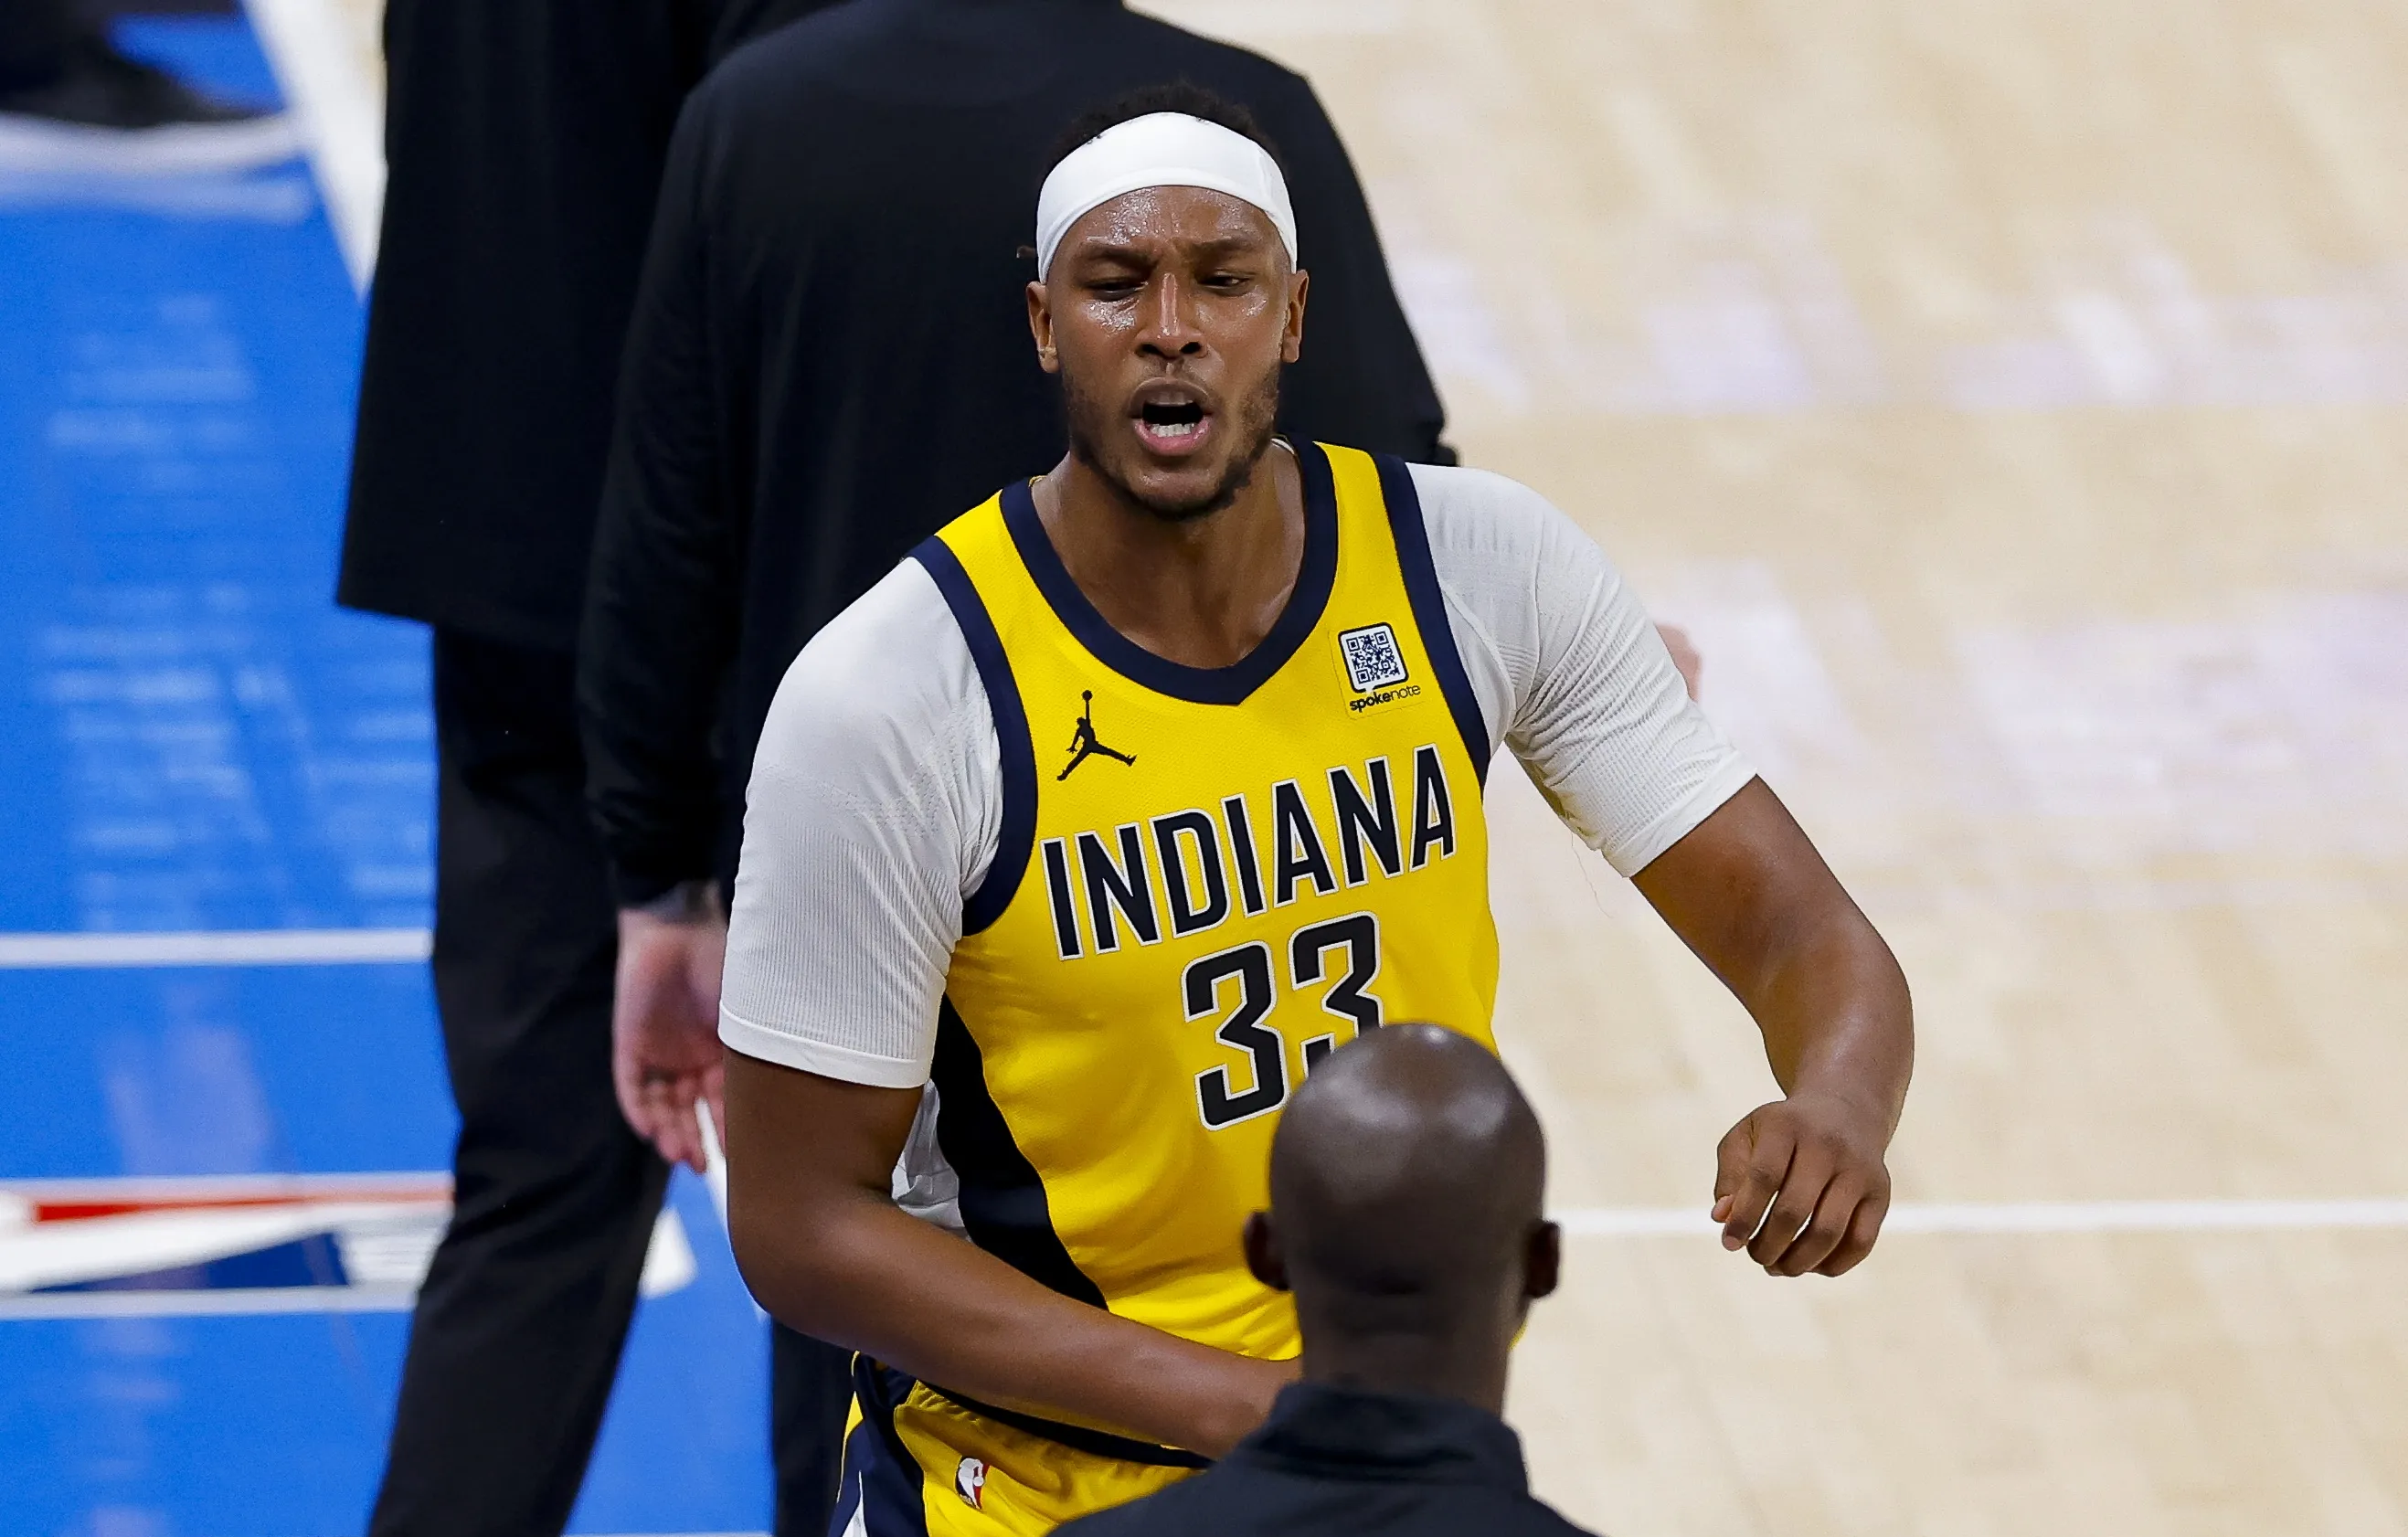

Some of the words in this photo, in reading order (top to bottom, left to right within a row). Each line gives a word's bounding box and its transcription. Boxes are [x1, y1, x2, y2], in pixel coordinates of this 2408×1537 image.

[1349, 685, 1421, 713] spokenote
[1040, 743, 1457, 961] INDIANA
[1181, 910, 1384, 1130] 33
